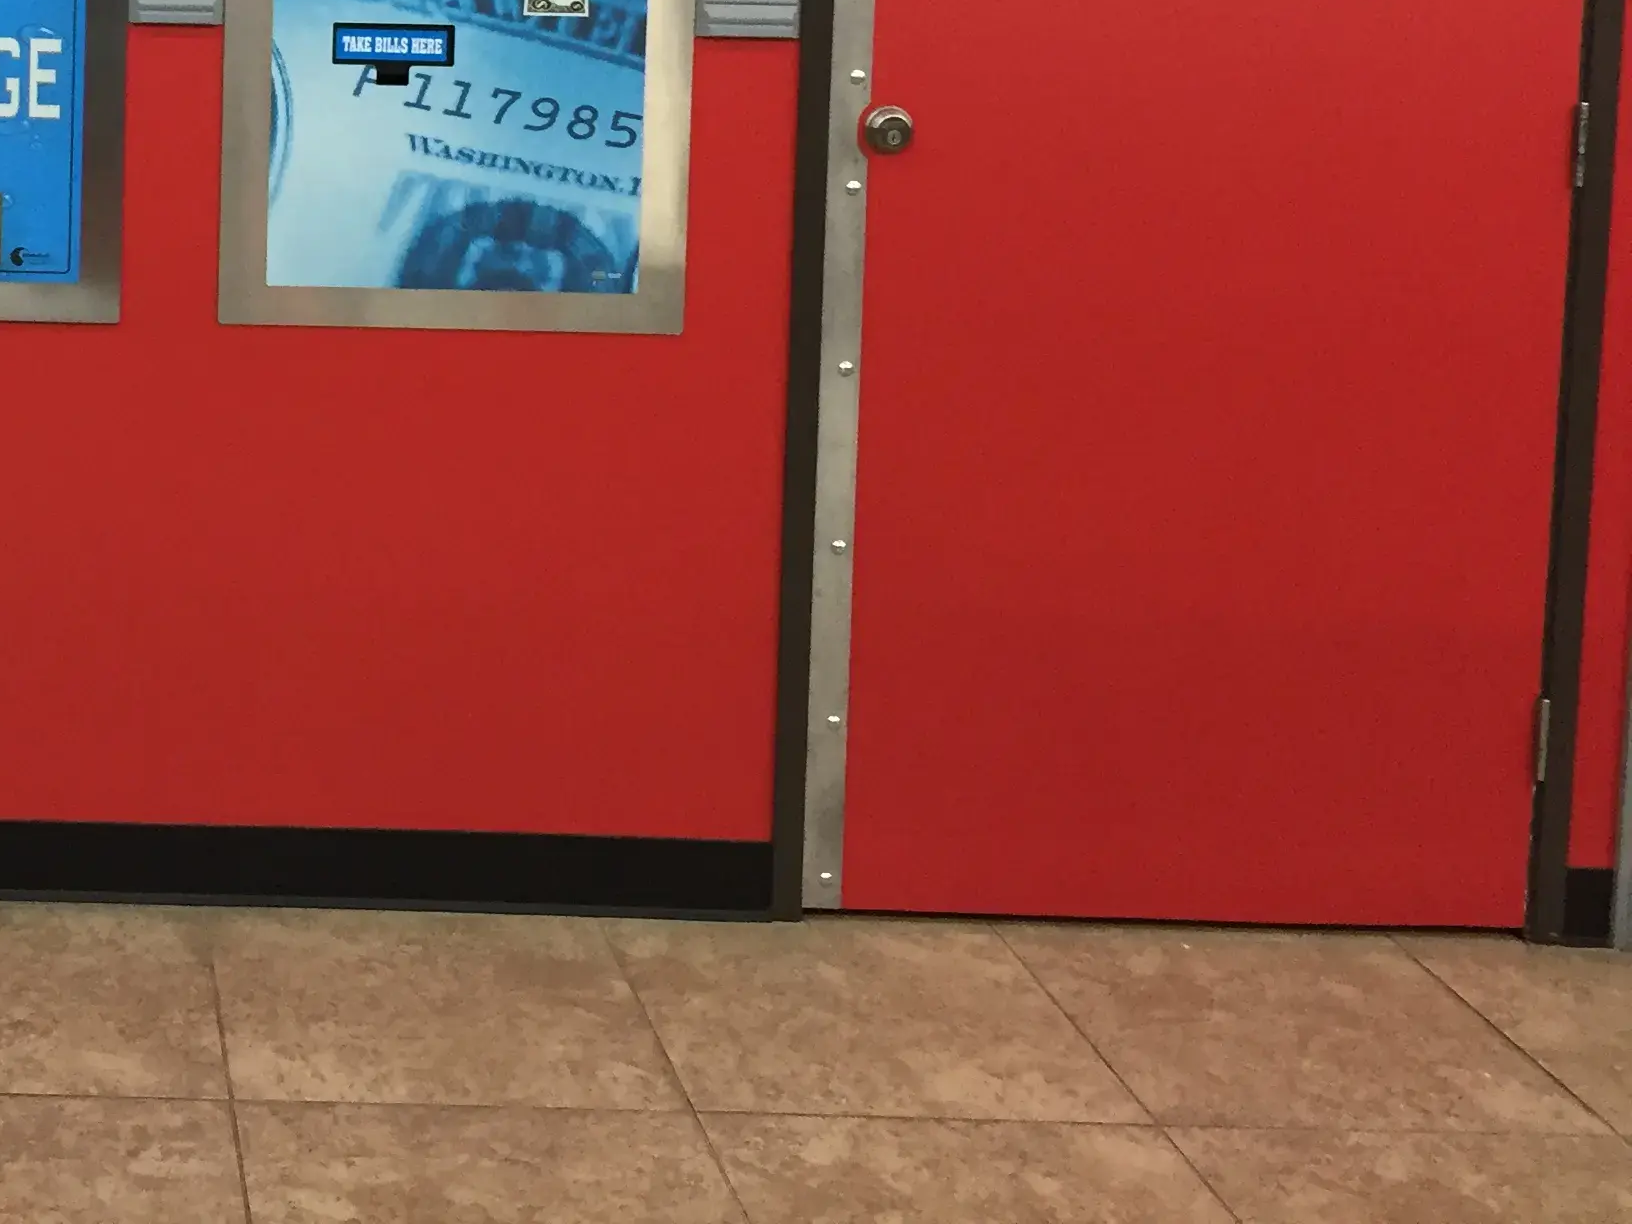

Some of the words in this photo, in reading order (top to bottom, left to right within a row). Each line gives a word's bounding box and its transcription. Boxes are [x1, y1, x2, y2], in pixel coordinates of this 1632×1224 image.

[341, 35, 372, 53] TAKE
[374, 36, 409, 54] BILLS
[411, 37, 444, 55] HERE
